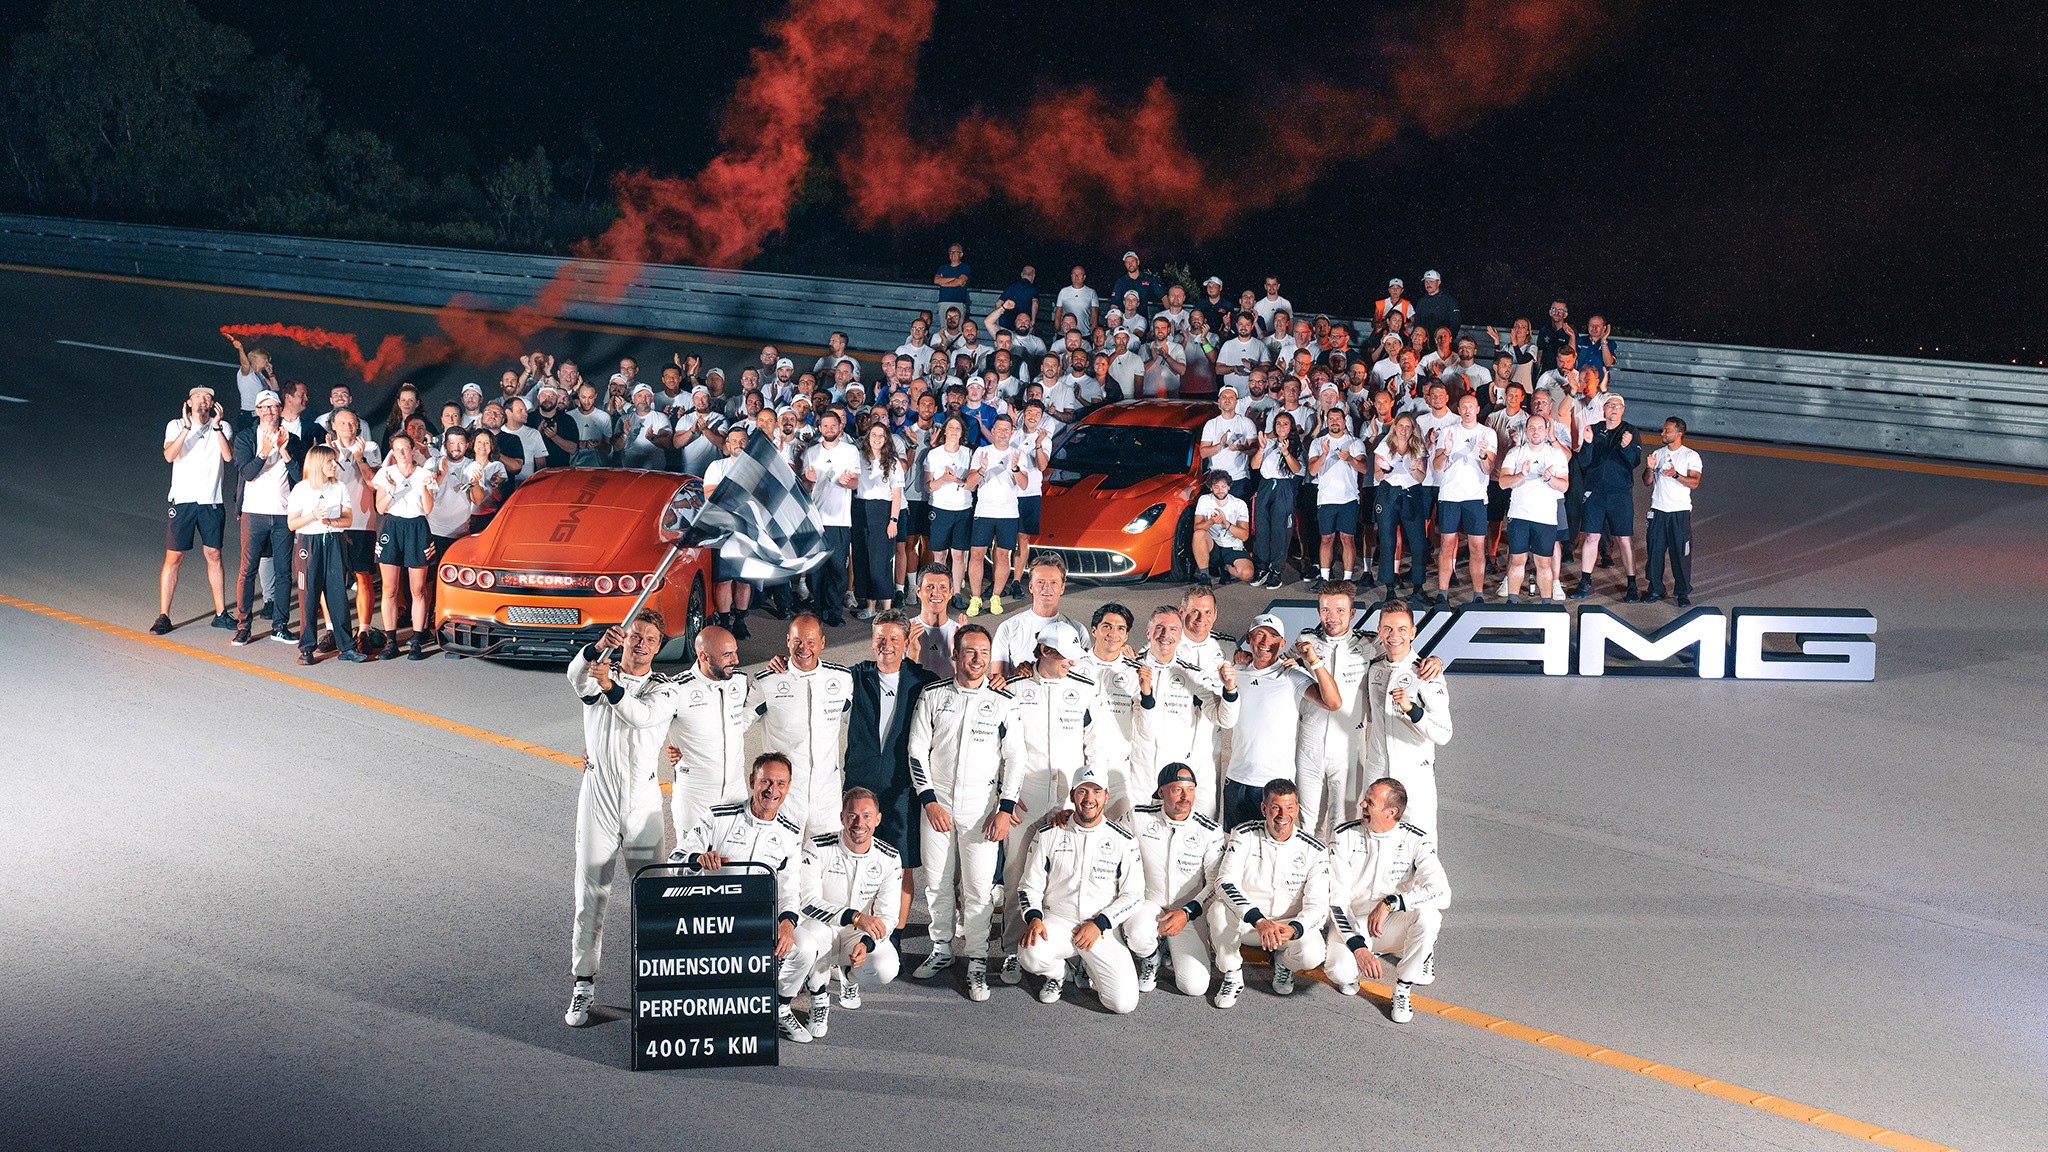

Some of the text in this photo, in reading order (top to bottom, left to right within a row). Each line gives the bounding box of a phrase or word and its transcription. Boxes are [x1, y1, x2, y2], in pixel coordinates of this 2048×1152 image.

[549, 489, 596, 543] AMG
[518, 574, 573, 586] RECORD
[1422, 608, 1878, 682] AMG
[687, 884, 743, 896] AMG
[675, 916, 735, 935] A NEW
[639, 955, 771, 977] DIMENSION OF
[639, 996, 771, 1018] PERFORMANCE
[645, 1036, 758, 1058] 40075 KM
